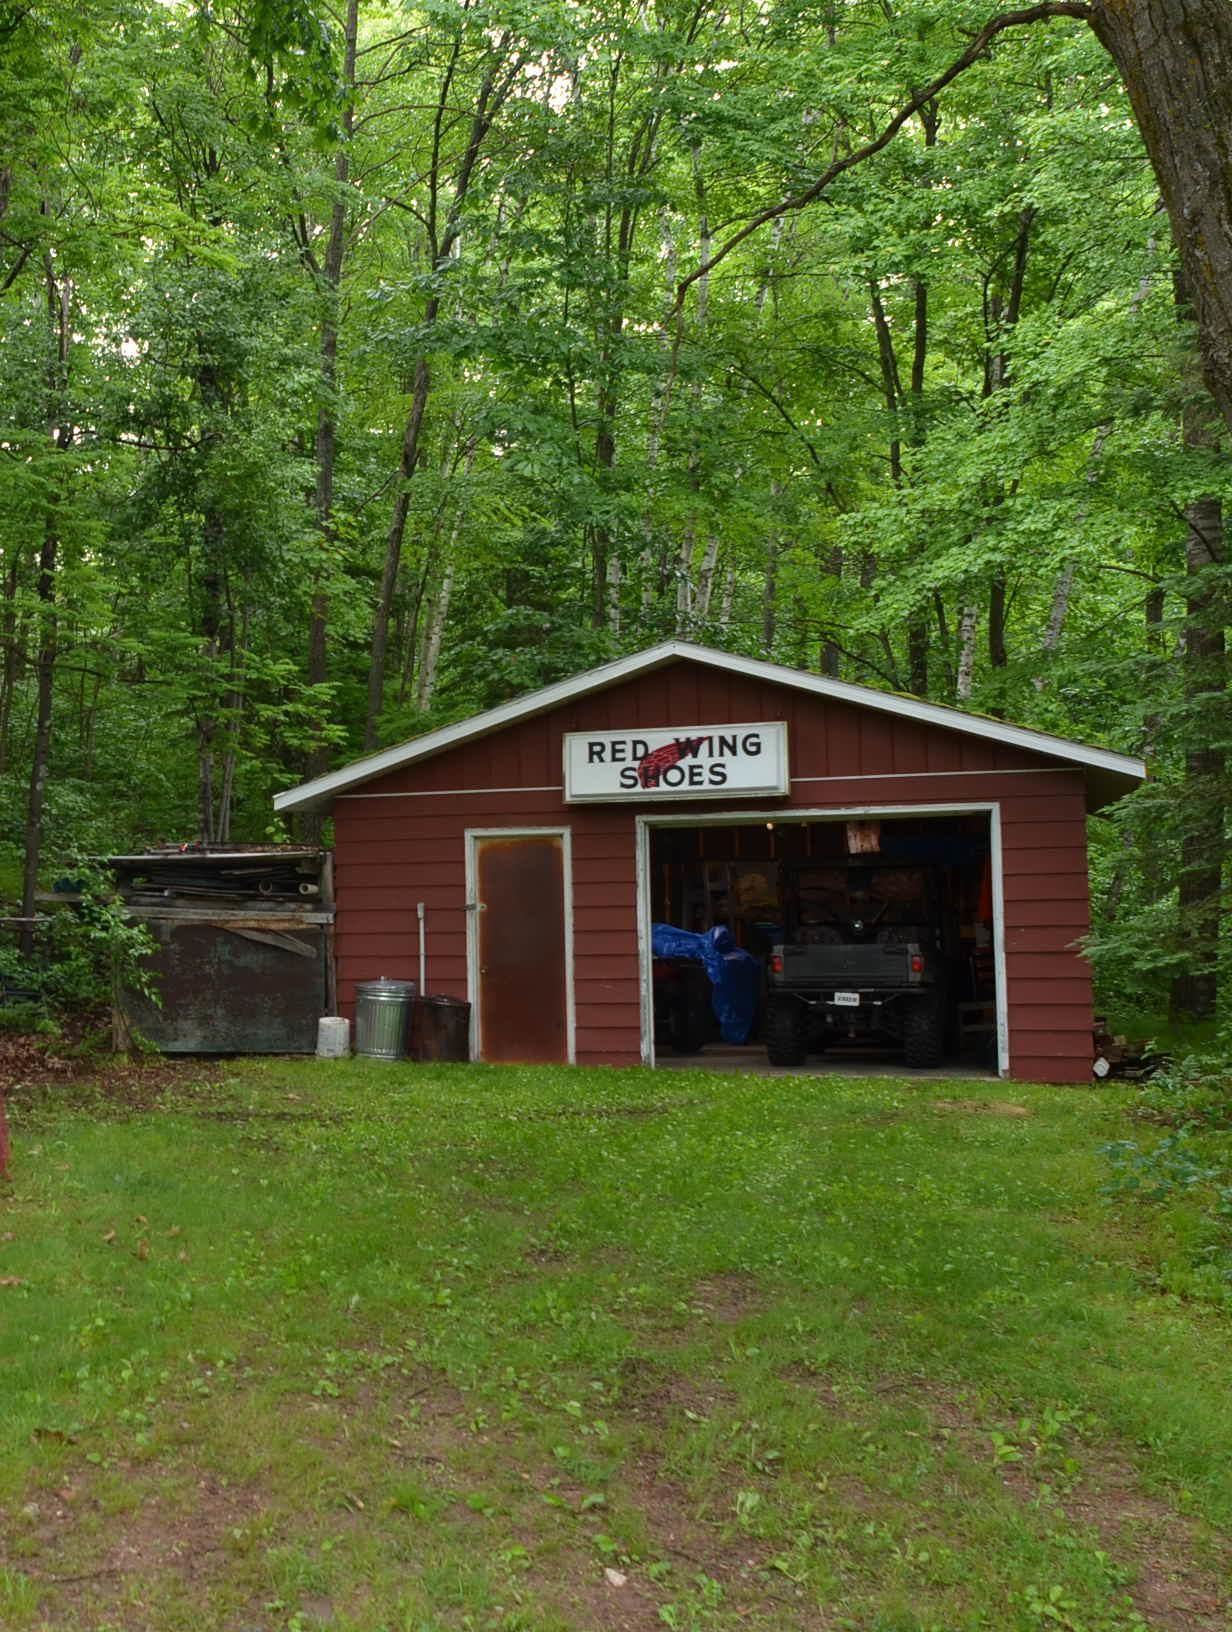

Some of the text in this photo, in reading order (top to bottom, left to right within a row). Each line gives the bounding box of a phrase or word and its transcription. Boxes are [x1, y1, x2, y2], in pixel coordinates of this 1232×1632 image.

[587, 733, 761, 764] RED WING
[620, 763, 727, 790] SHOES
